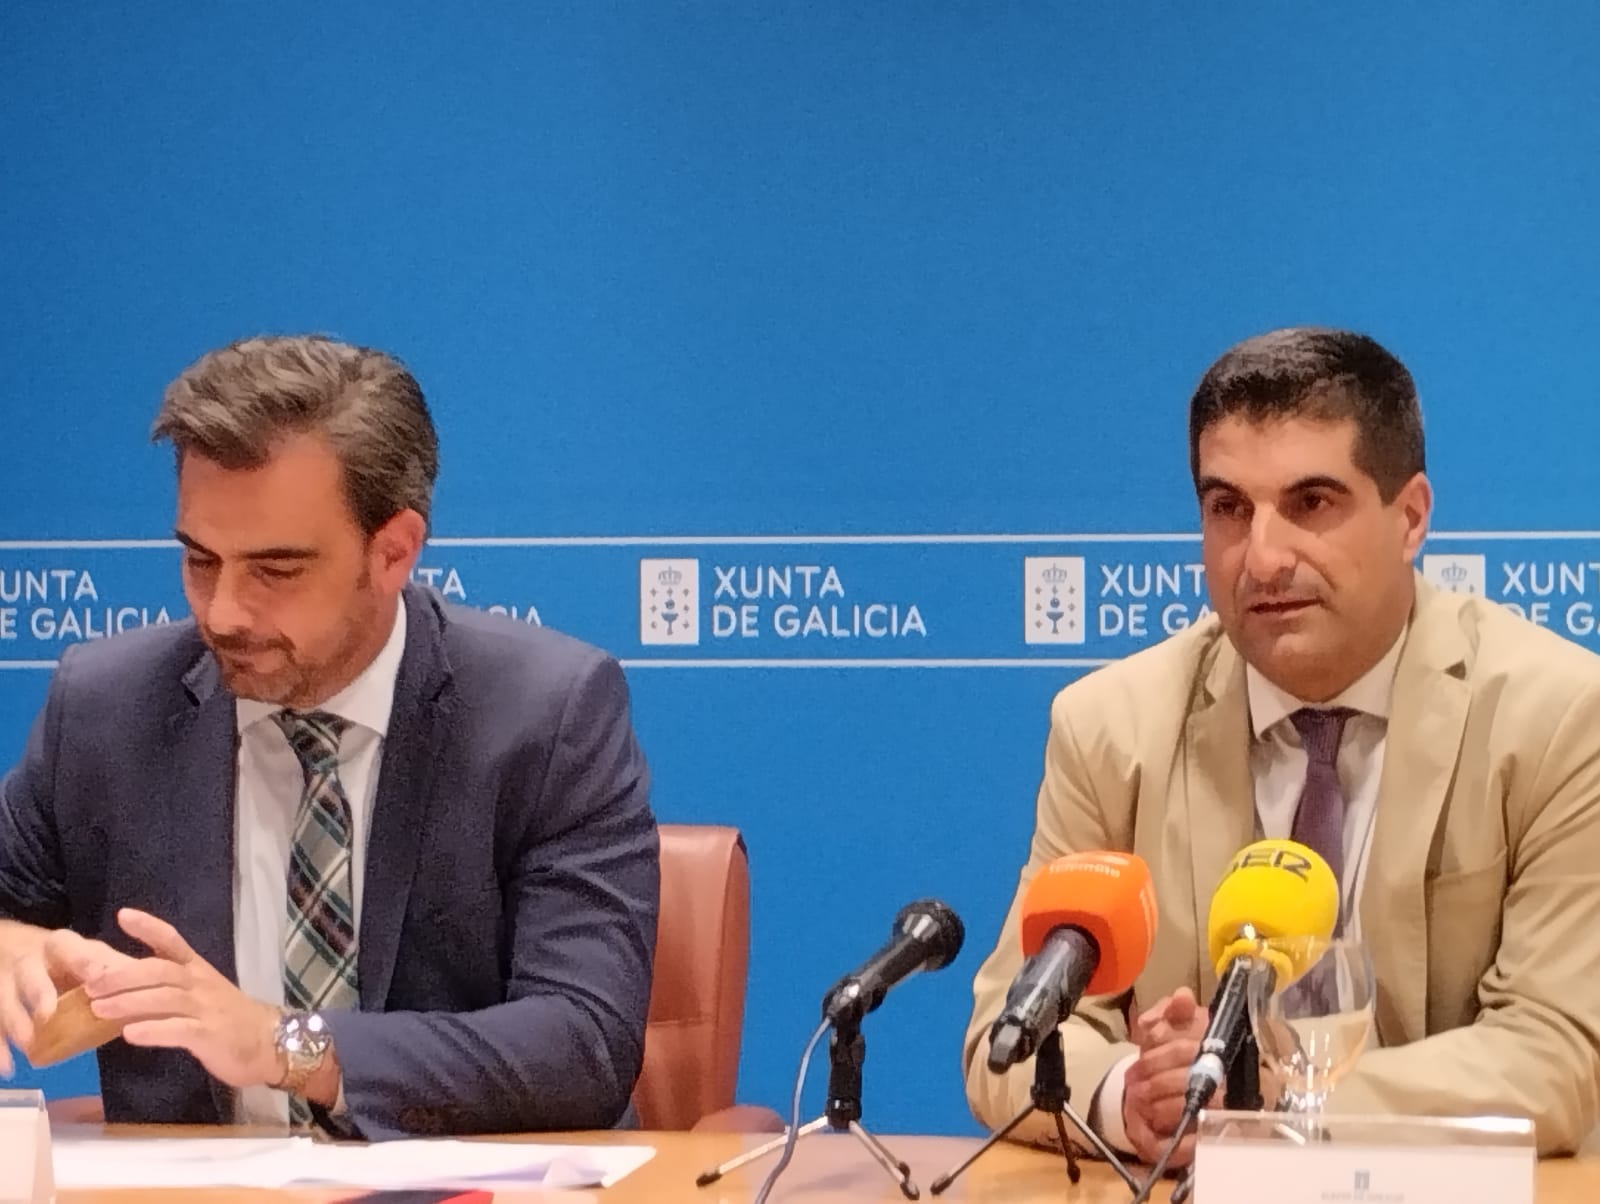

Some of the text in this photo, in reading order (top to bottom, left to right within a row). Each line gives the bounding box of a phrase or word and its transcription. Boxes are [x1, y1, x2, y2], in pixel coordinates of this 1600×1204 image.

[714, 565, 844, 599] XUNTA
[713, 604, 927, 638] DE GALICIA
[1100, 603, 1148, 636] DE
[1230, 848, 1313, 884] ER
